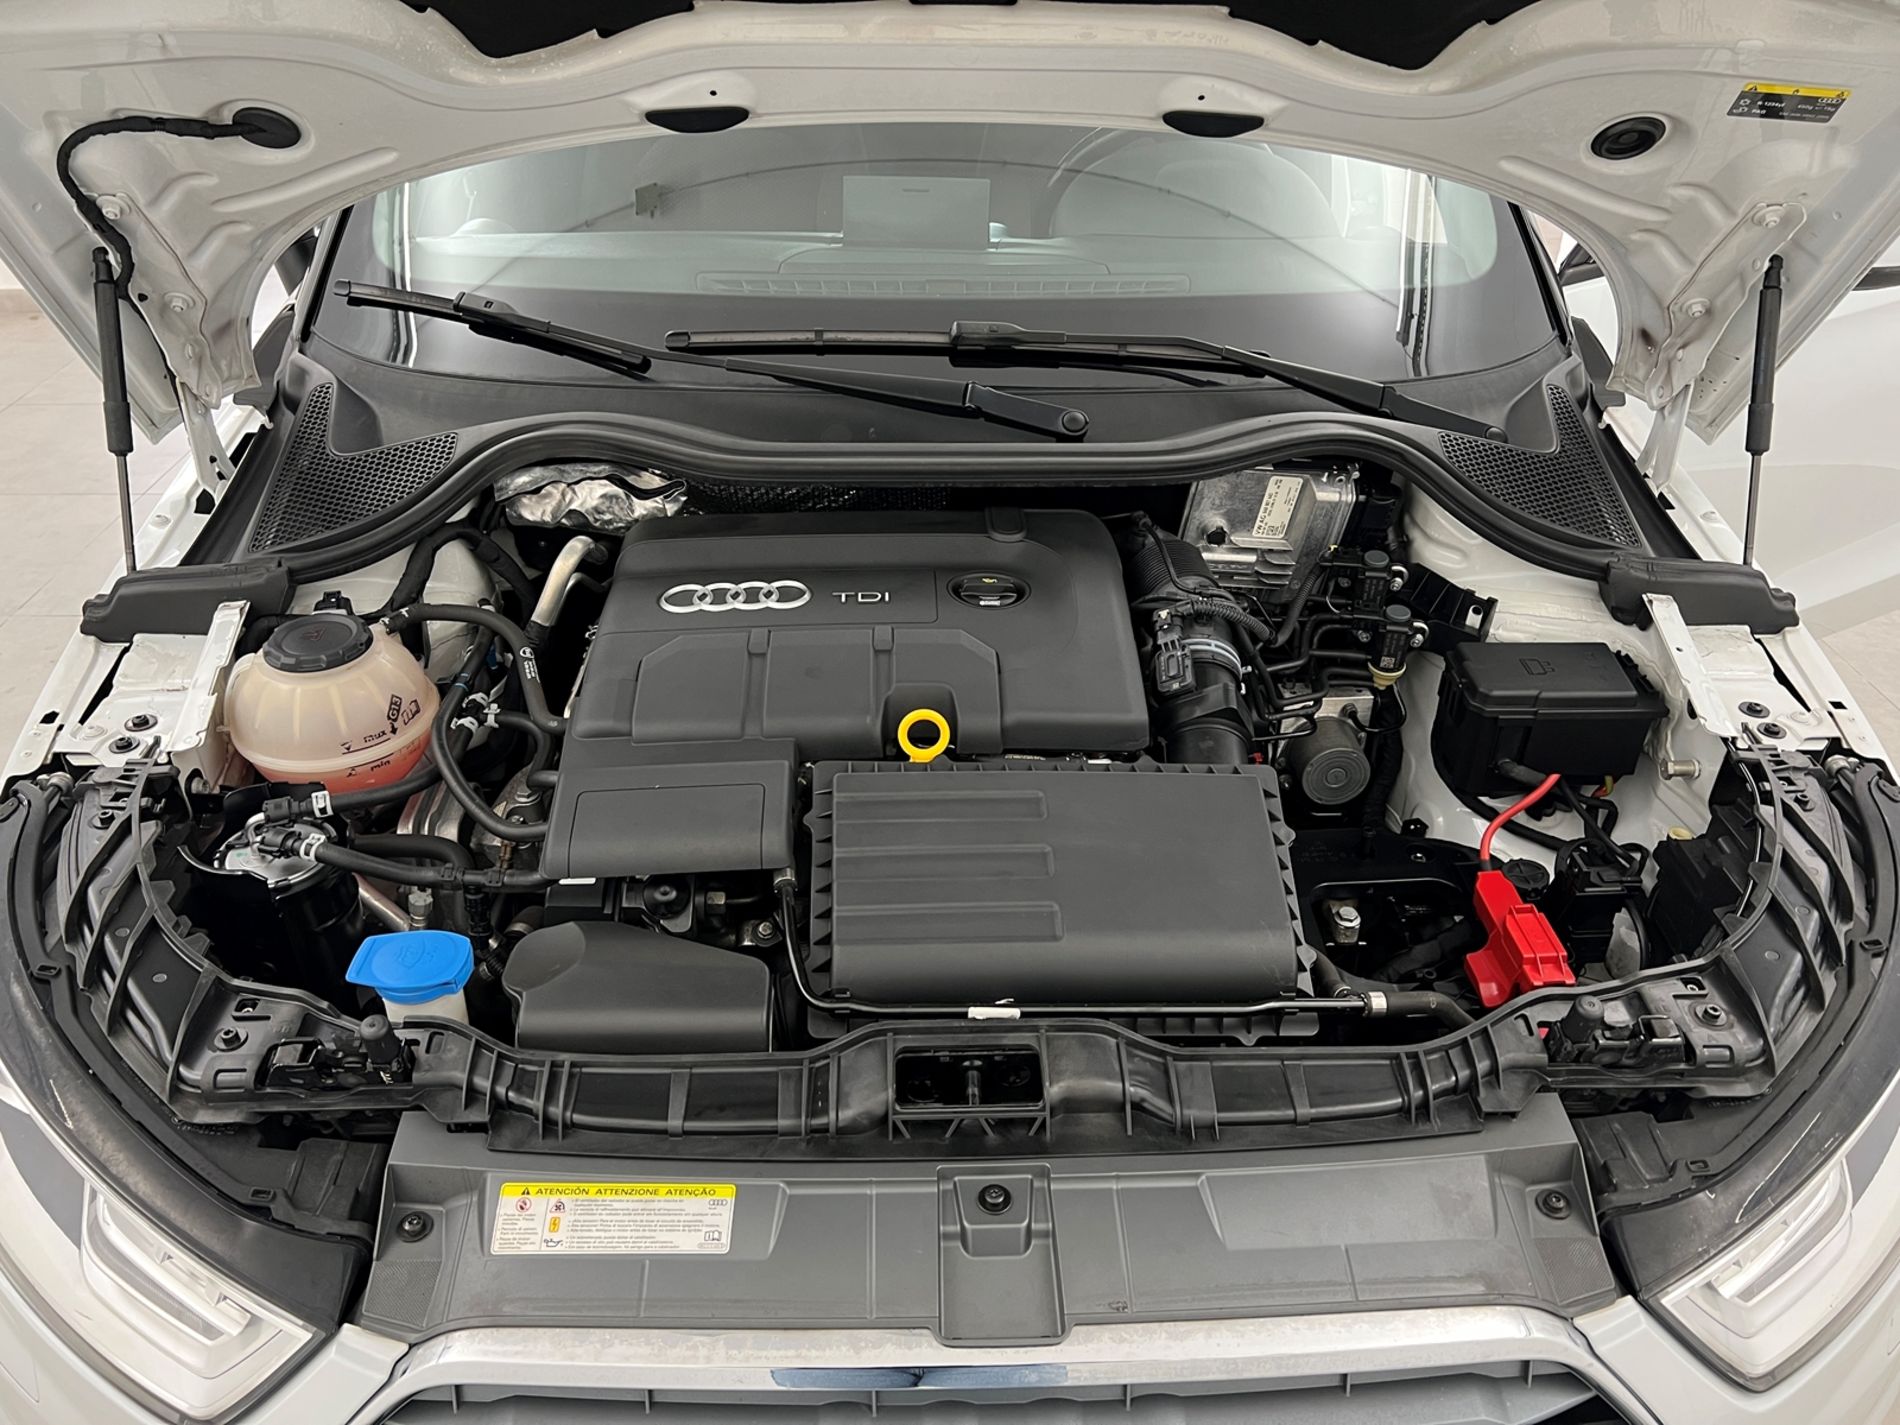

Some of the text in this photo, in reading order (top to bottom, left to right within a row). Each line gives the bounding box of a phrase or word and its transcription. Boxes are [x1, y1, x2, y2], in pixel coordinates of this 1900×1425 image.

[832, 591, 890, 603] TDI
[389, 698, 401, 718] G13
[370, 760, 391, 771] min
[536, 1186, 717, 1197] ATENCIÓN ATTENZIONE ATENÇÃO
